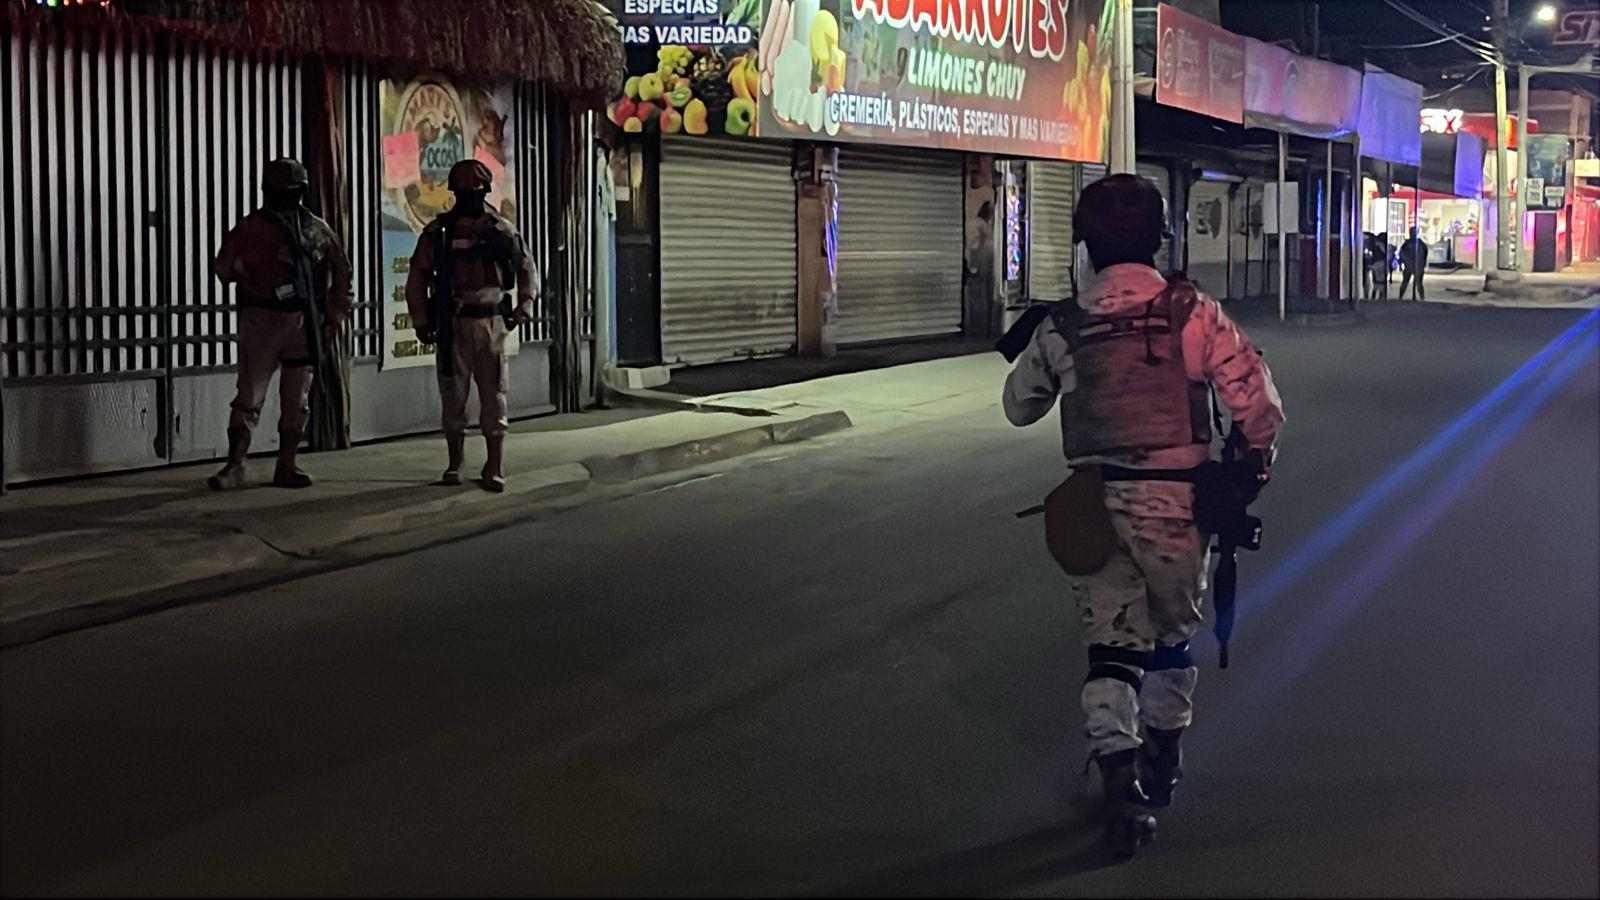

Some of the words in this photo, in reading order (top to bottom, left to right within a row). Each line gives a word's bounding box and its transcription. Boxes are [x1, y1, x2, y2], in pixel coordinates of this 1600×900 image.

[624, 0, 718, 14] ESPECIAS
[655, 26, 752, 44] VARIEDAD
[907, 47, 985, 95] LIMONES
[986, 61, 1026, 101] CHUY
[831, 91, 896, 134] CREMERÍA,
[899, 96, 960, 140] PLÁSTICOS,
[963, 109, 1010, 138] ESPECIAS
[1011, 115, 1019, 139] Y
[1019, 116, 1039, 141] MAS
